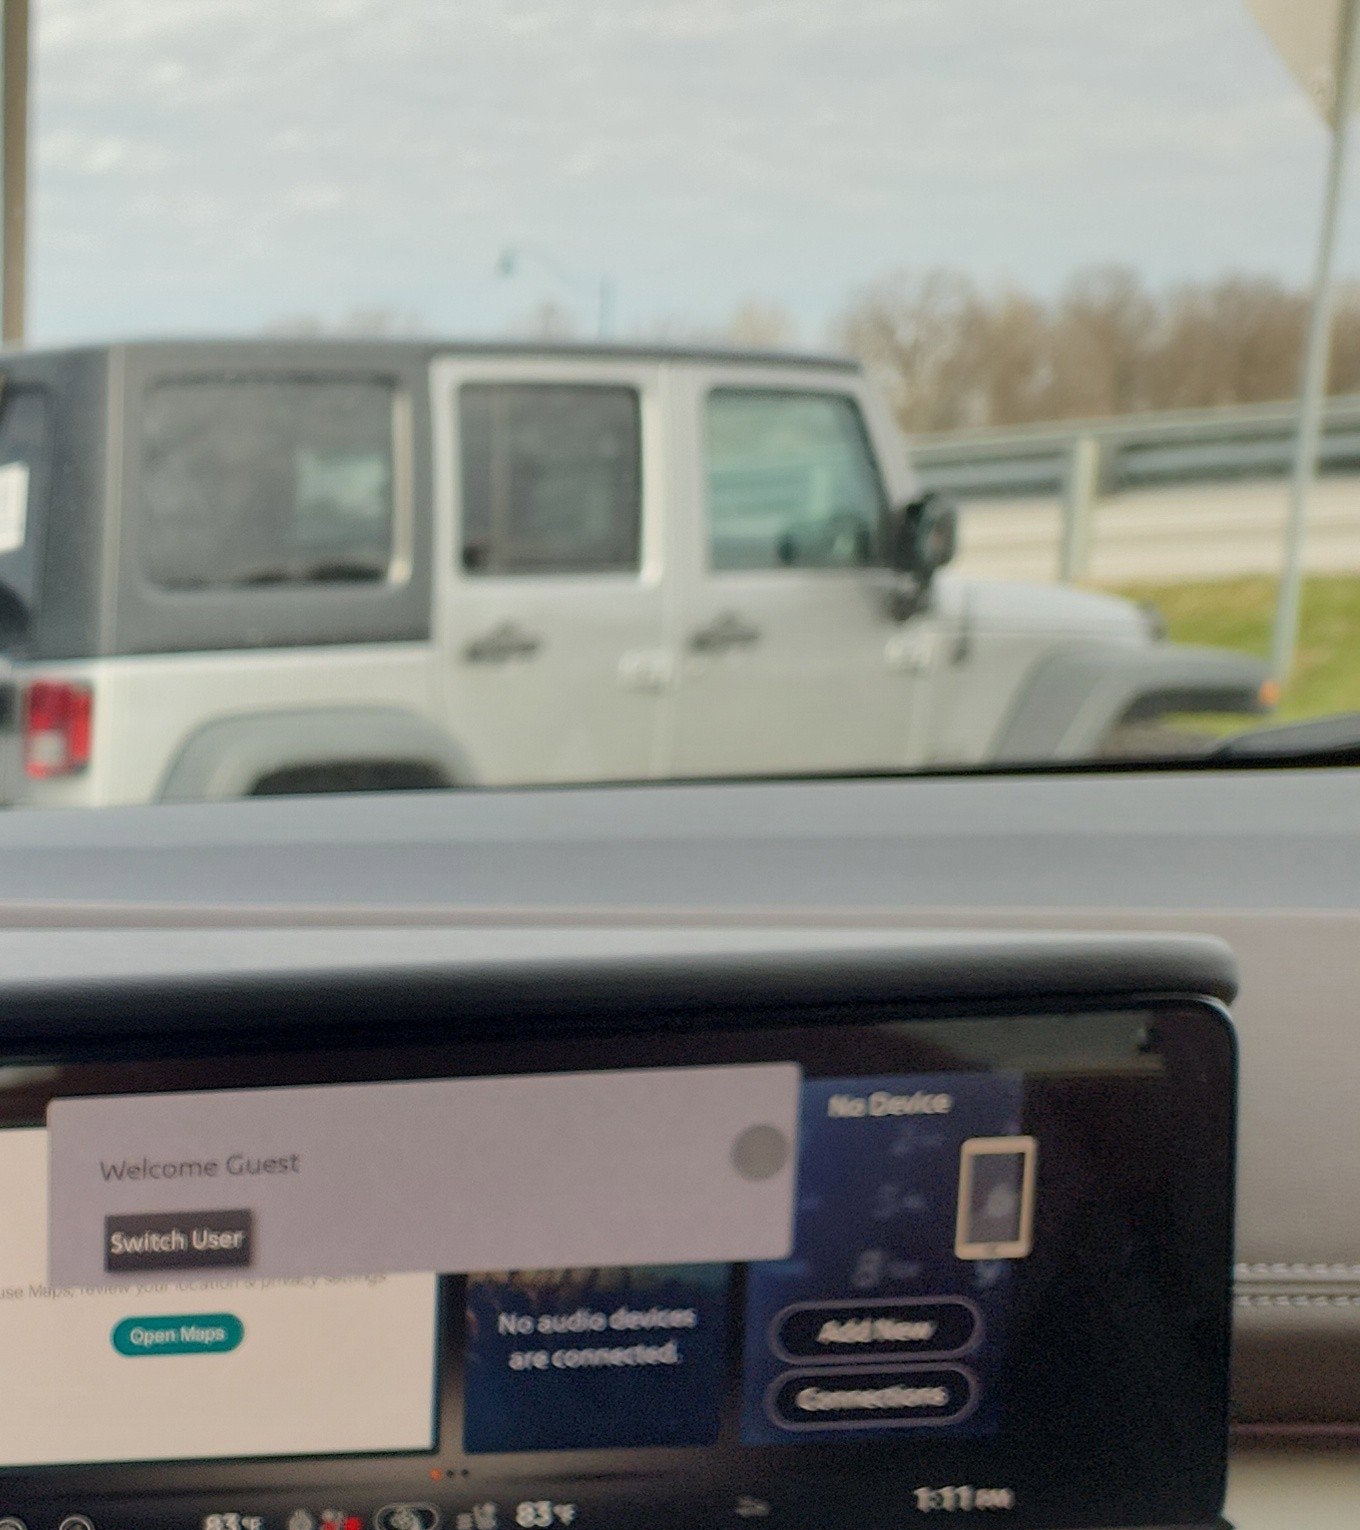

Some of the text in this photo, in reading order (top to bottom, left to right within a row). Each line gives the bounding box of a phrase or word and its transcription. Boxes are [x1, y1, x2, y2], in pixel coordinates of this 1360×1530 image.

[828, 1090, 951, 1118] No Device
[99, 1153, 301, 1182] Welcome Guest
[109, 1228, 246, 1255] Switch User
[498, 1306, 697, 1336] No audio devices
[816, 1317, 936, 1345] Add New
[129, 1324, 226, 1347] Open Maps
[508, 1350, 549, 1371] are
[796, 1384, 948, 1412] Connections
[913, 1485, 973, 1513] 1:11
